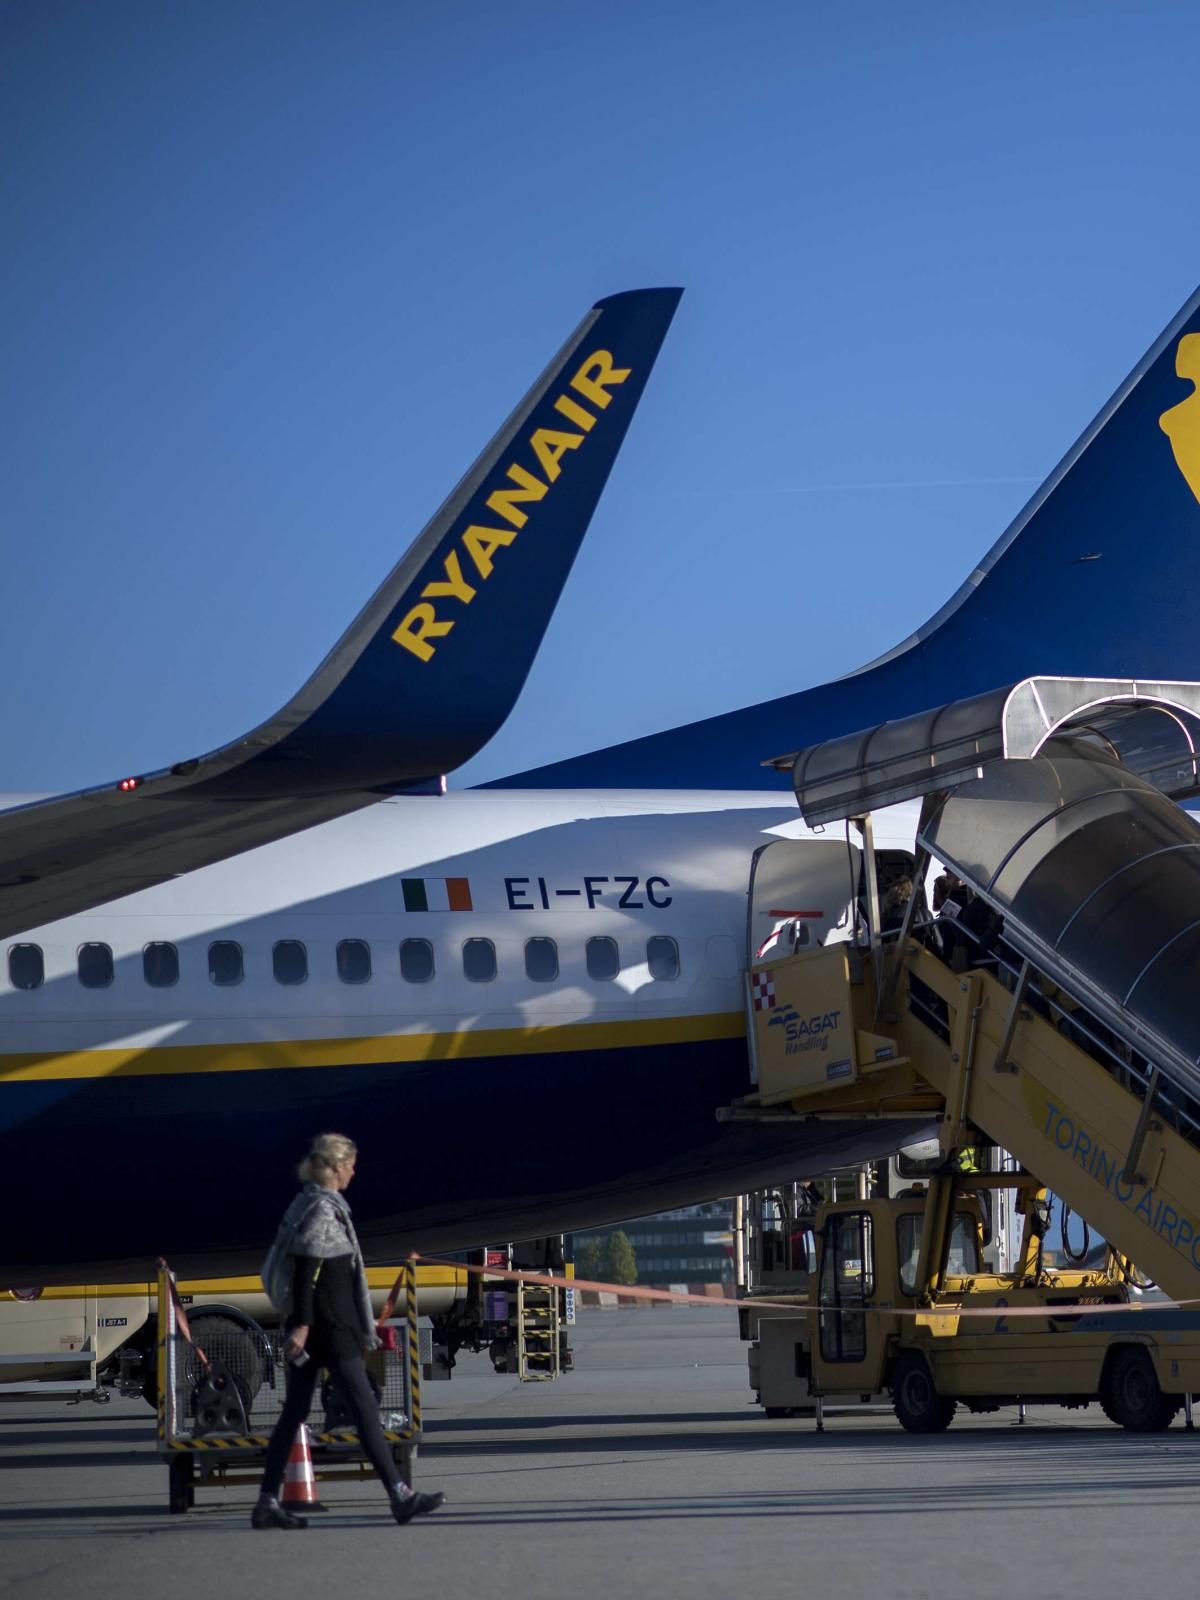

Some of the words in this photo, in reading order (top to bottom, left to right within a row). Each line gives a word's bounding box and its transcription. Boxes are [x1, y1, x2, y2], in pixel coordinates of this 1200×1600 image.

[391, 349, 632, 663] RYANAIR
[504, 876, 672, 910] EI-FZC
[785, 1011, 841, 1041] SAGAT
[785, 1035, 830, 1056] Handling
[1045, 1103, 1134, 1202] TORINO
[995, 1297, 1009, 1332] 2
